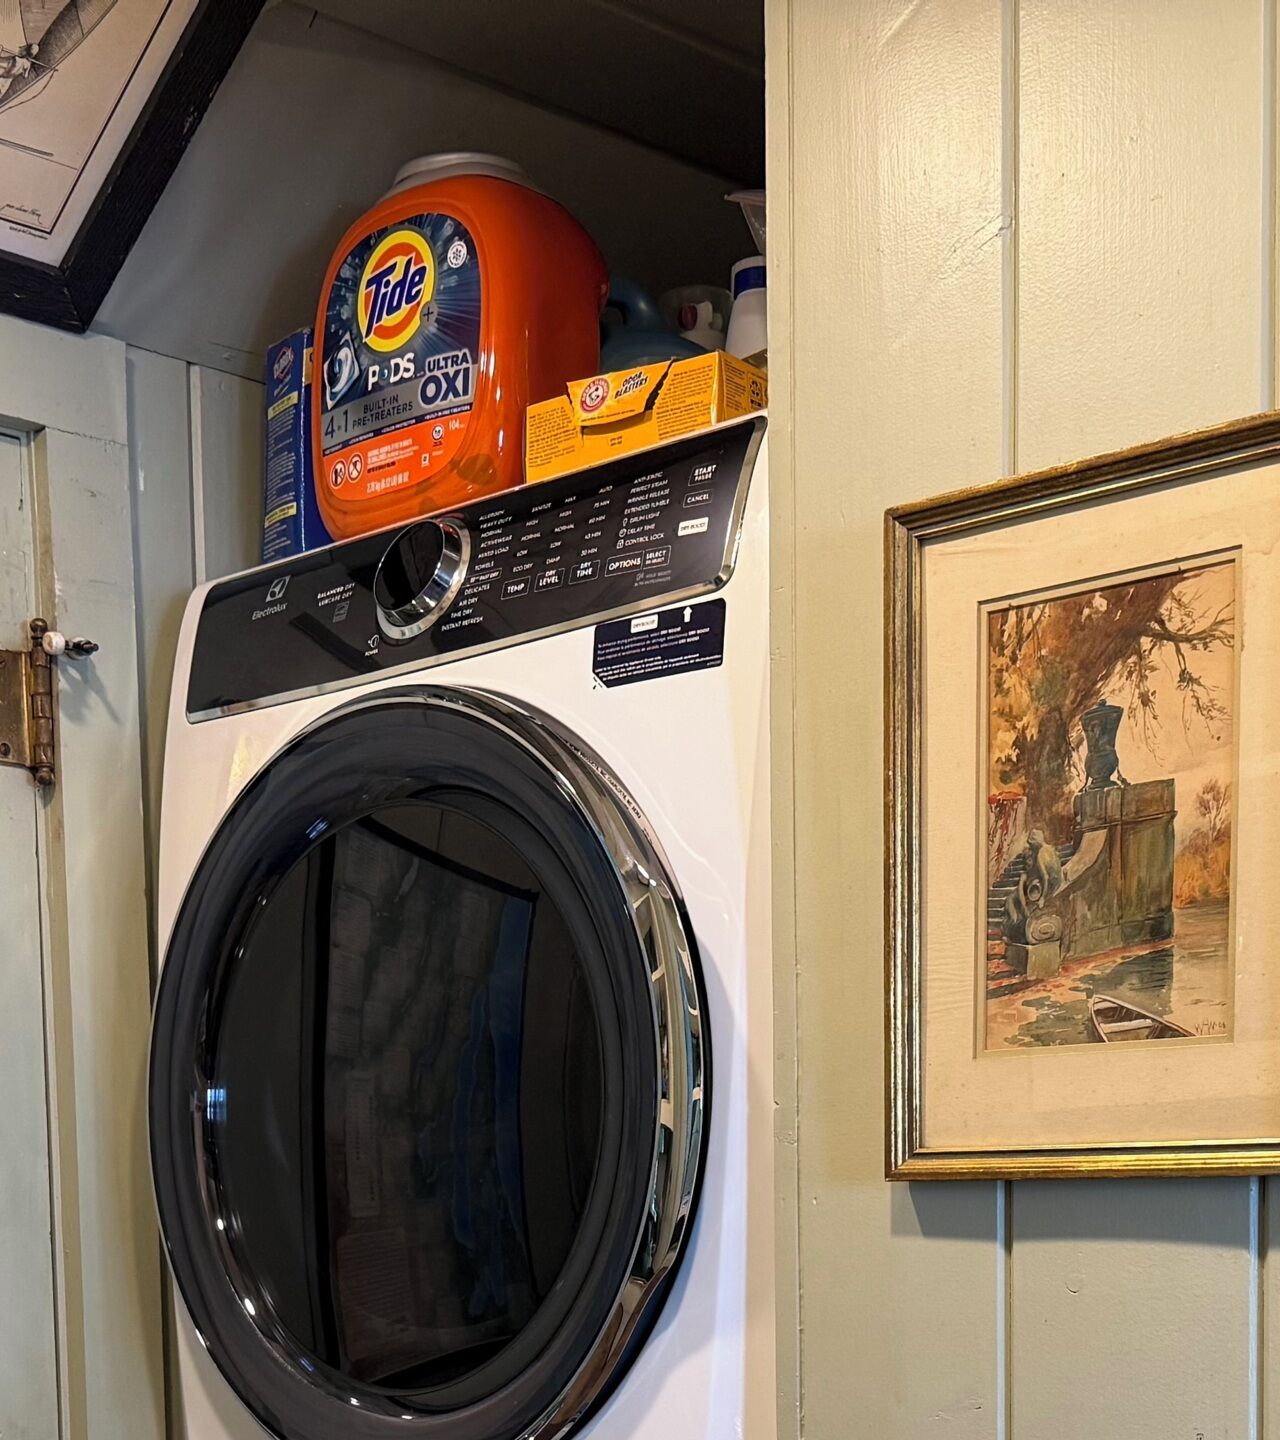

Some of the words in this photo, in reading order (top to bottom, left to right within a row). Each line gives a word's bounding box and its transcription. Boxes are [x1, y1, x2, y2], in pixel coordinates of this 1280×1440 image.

[363, 252, 428, 343] Tide
[427, 351, 470, 373] ULTRA
[420, 367, 470, 406] OXI
[363, 394, 399, 415] BUILT-IN
[352, 402, 413, 430] PRE-TREATERS
[694, 464, 716, 477] START
[687, 493, 709, 503] CANCEL
[624, 536, 649, 546] CONTROL
[608, 557, 641, 571] OPTIONS
[576, 567, 593, 578] TIME
[539, 576, 559, 586] LEVEL
[507, 583, 525, 594] TEMP
[252, 602, 288, 621] Electrolux
